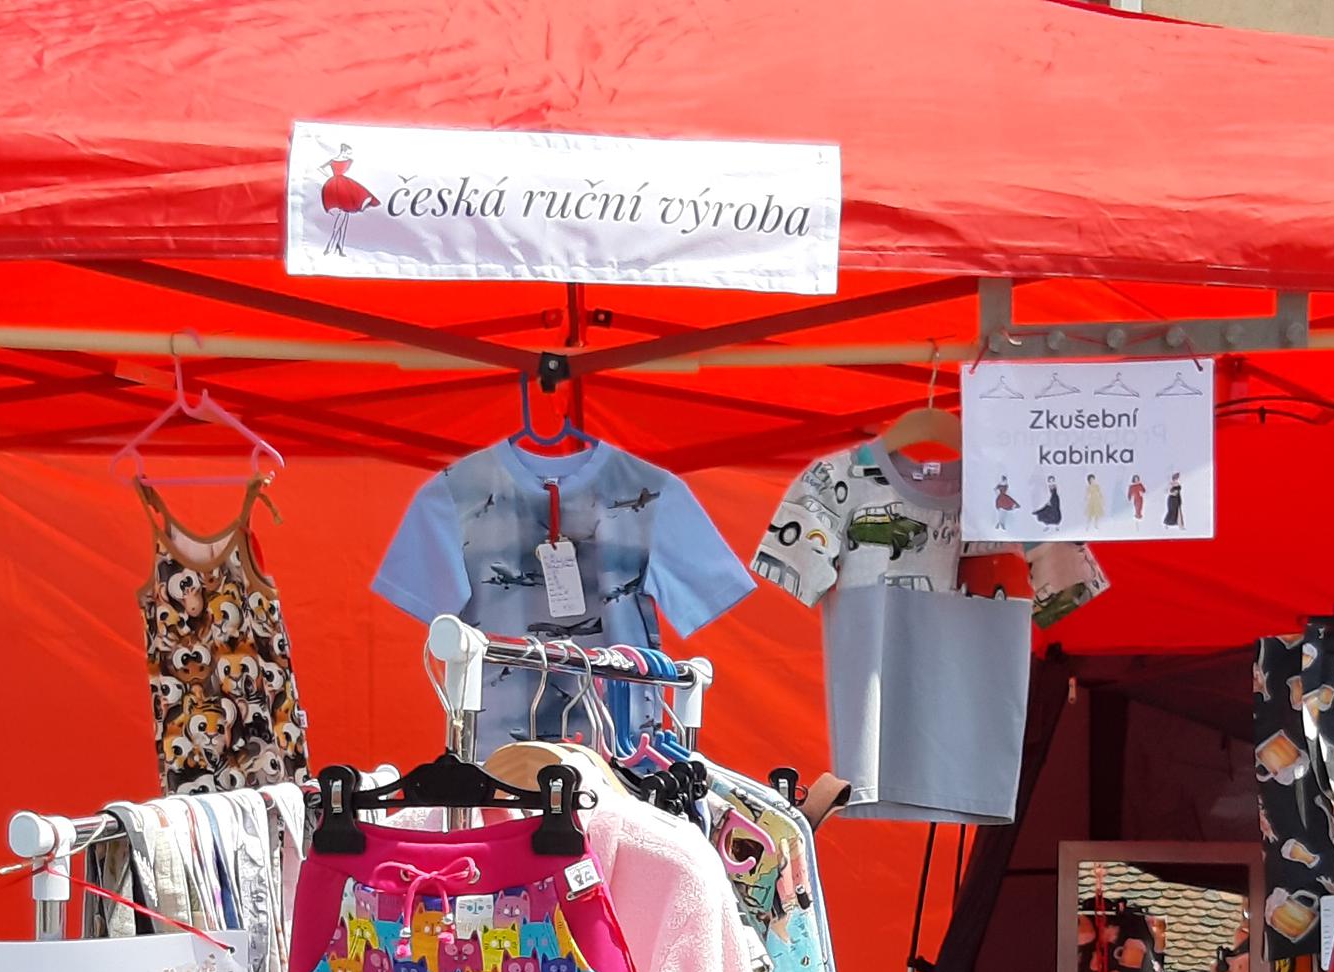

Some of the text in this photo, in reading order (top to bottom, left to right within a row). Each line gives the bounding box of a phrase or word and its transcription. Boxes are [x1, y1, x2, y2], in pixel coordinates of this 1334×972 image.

[386, 174, 811, 238] česká ruční výroba
[1028, 408, 1140, 430] Zkušební
[1038, 444, 1135, 465] kabinka
